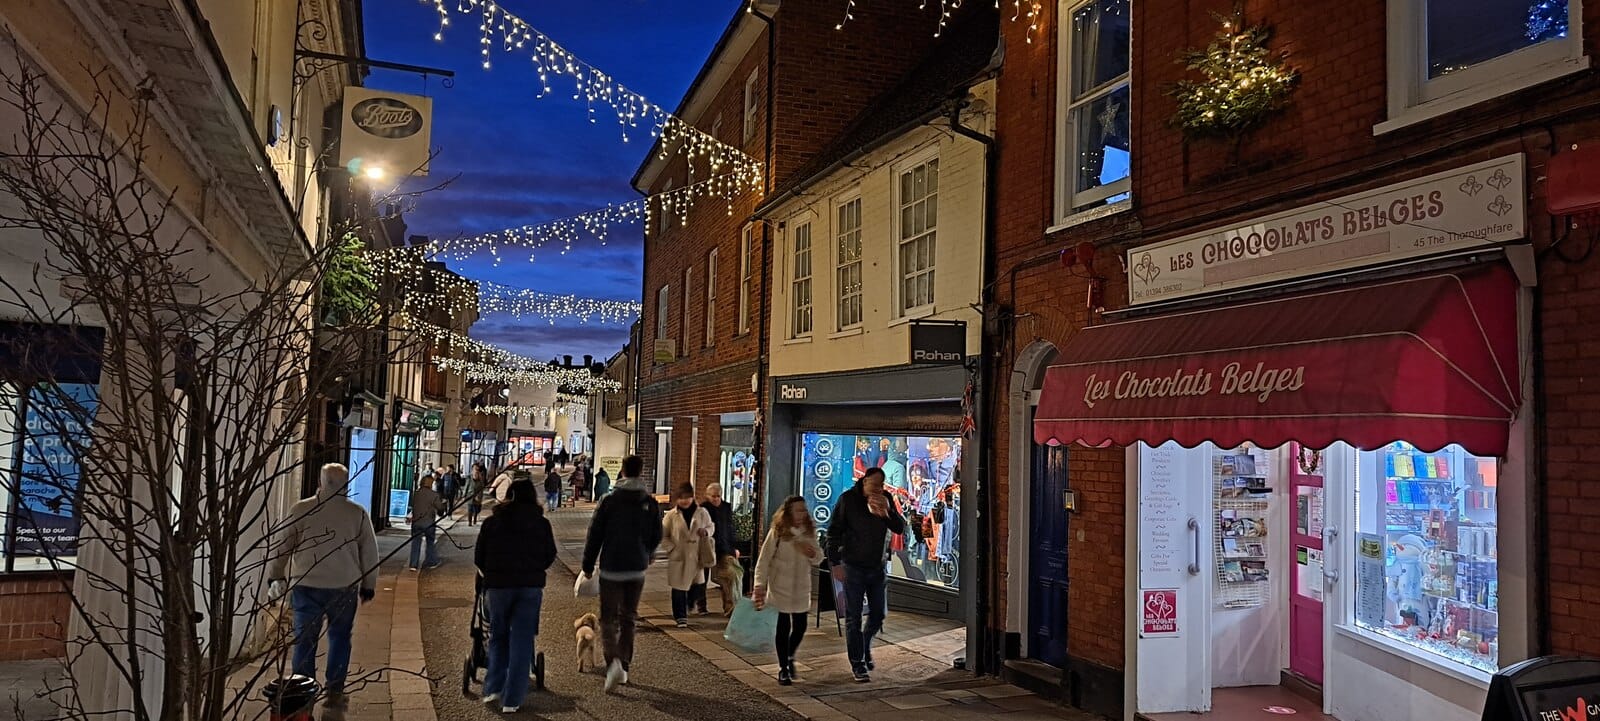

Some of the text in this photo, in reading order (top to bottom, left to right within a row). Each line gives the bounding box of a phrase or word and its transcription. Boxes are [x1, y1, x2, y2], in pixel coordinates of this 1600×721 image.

[359, 103, 413, 129] Boots
[1169, 190, 1445, 272] LES CHOCOLATS BELGES
[1413, 223, 1513, 248] 45 The Thoroughfare
[913, 350, 961, 361] Rohan
[781, 384, 807, 399] Rohan
[1083, 361, 1305, 409] Les Chocolats Belges
[15, 526, 41, 536] Spea
[1540, 709, 1561, 721] THE
